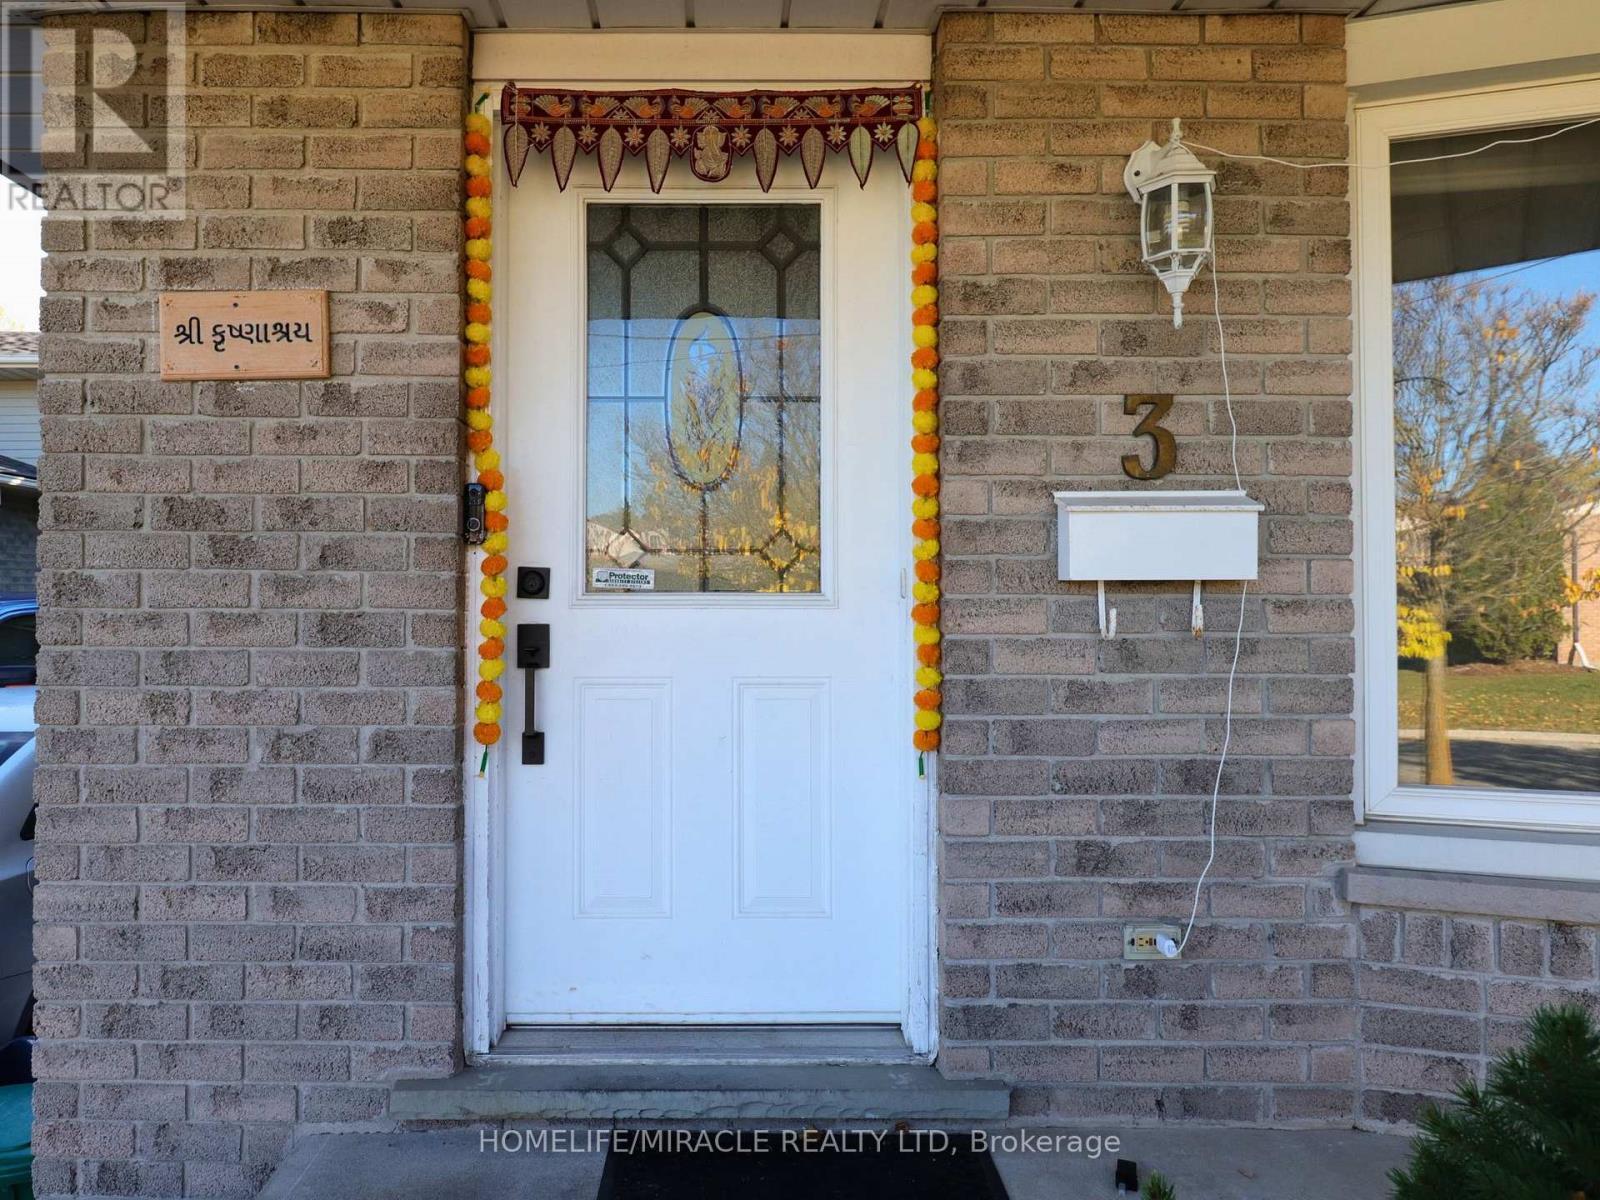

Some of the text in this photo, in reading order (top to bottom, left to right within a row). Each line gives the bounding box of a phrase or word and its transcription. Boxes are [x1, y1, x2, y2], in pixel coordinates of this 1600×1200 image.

[174, 316, 204, 345] શ્રી
[1121, 394, 1177, 481] 3
[609, 572, 649, 581] Protector
